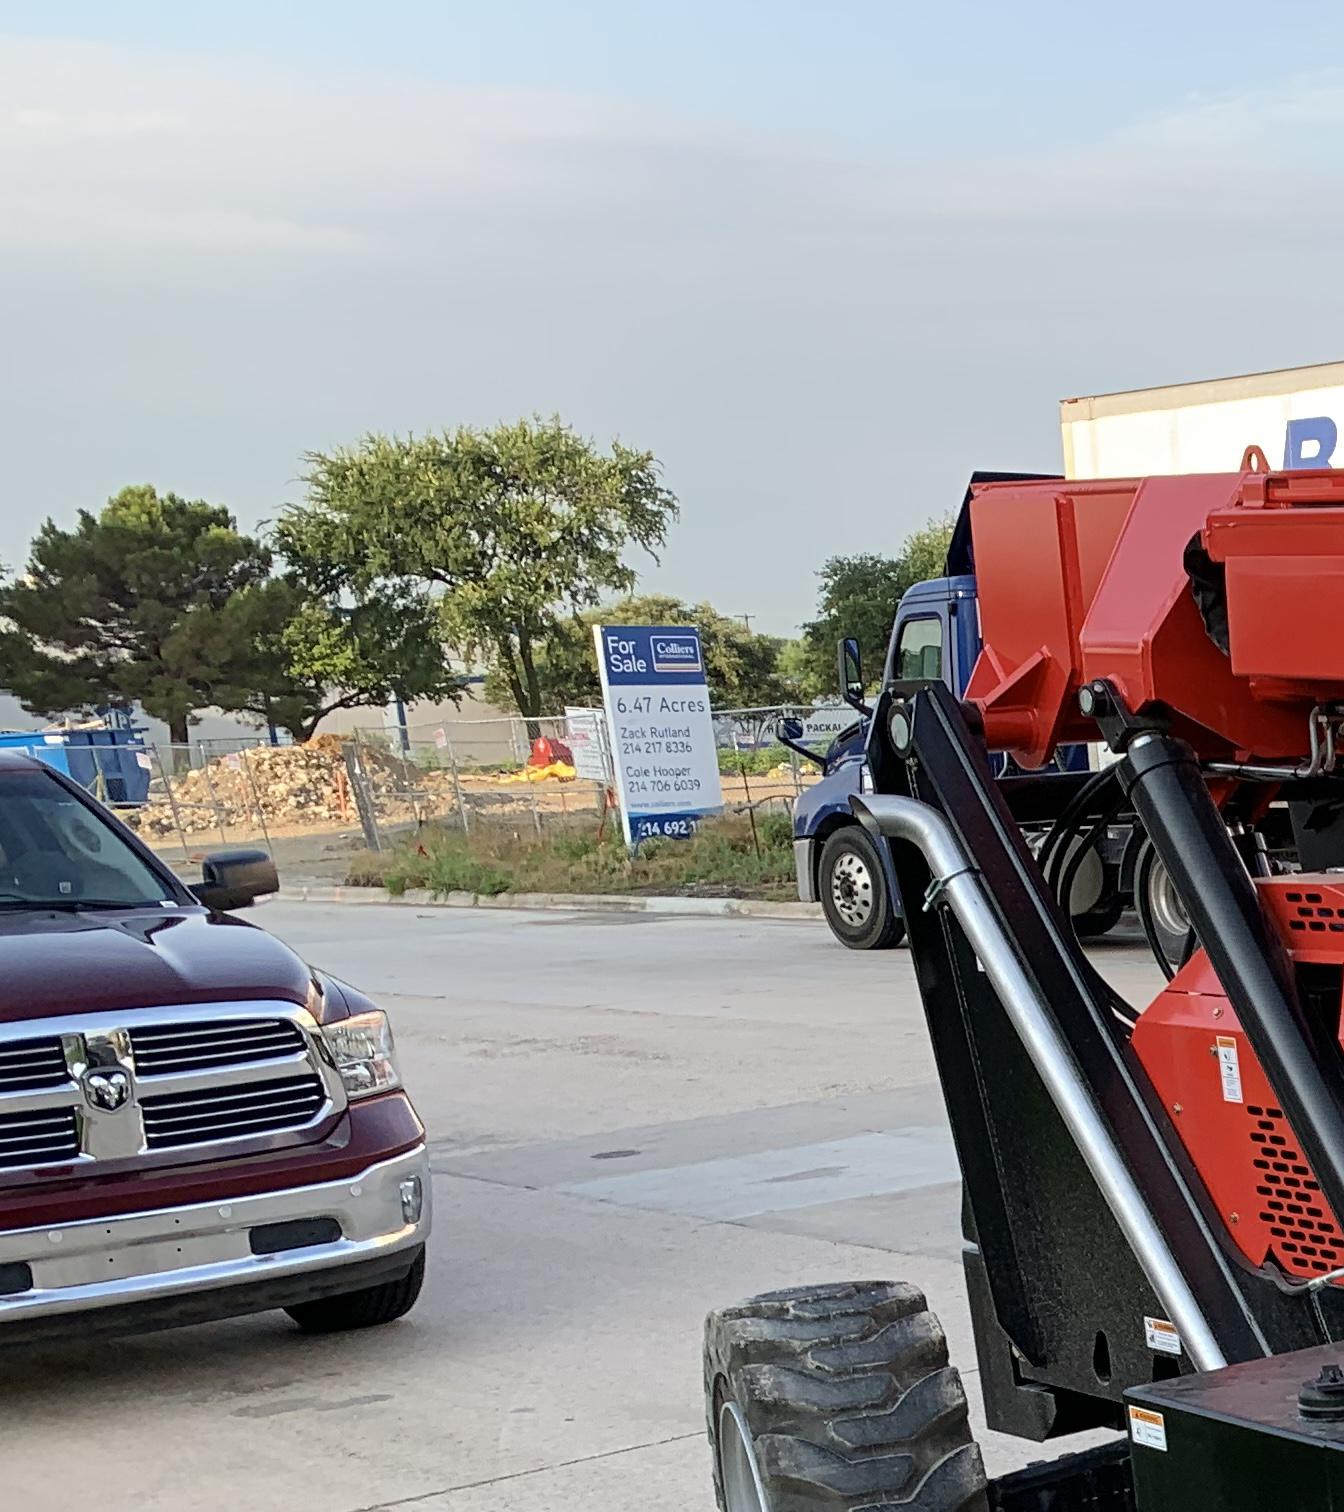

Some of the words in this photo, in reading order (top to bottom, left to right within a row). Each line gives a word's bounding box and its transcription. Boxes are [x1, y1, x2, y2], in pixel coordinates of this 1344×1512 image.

[607, 636, 636, 655] For
[656, 642, 694, 654] Colliers
[610, 654, 647, 673] Sale
[617, 697, 652, 714] 6.47
[659, 696, 705, 713] Acres
[620, 727, 647, 740] Zack
[650, 726, 691, 739] Rutland
[623, 742, 642, 754] 214
[645, 742, 662, 754] 217
[665, 741, 693, 754] 8336
[626, 766, 650, 778] Cole
[653, 766, 691, 779] Hooper
[629, 781, 648, 793] 214
[650, 780, 671, 792] 706
[674, 779, 701, 791] 6039
[663, 820, 688, 835] 692
